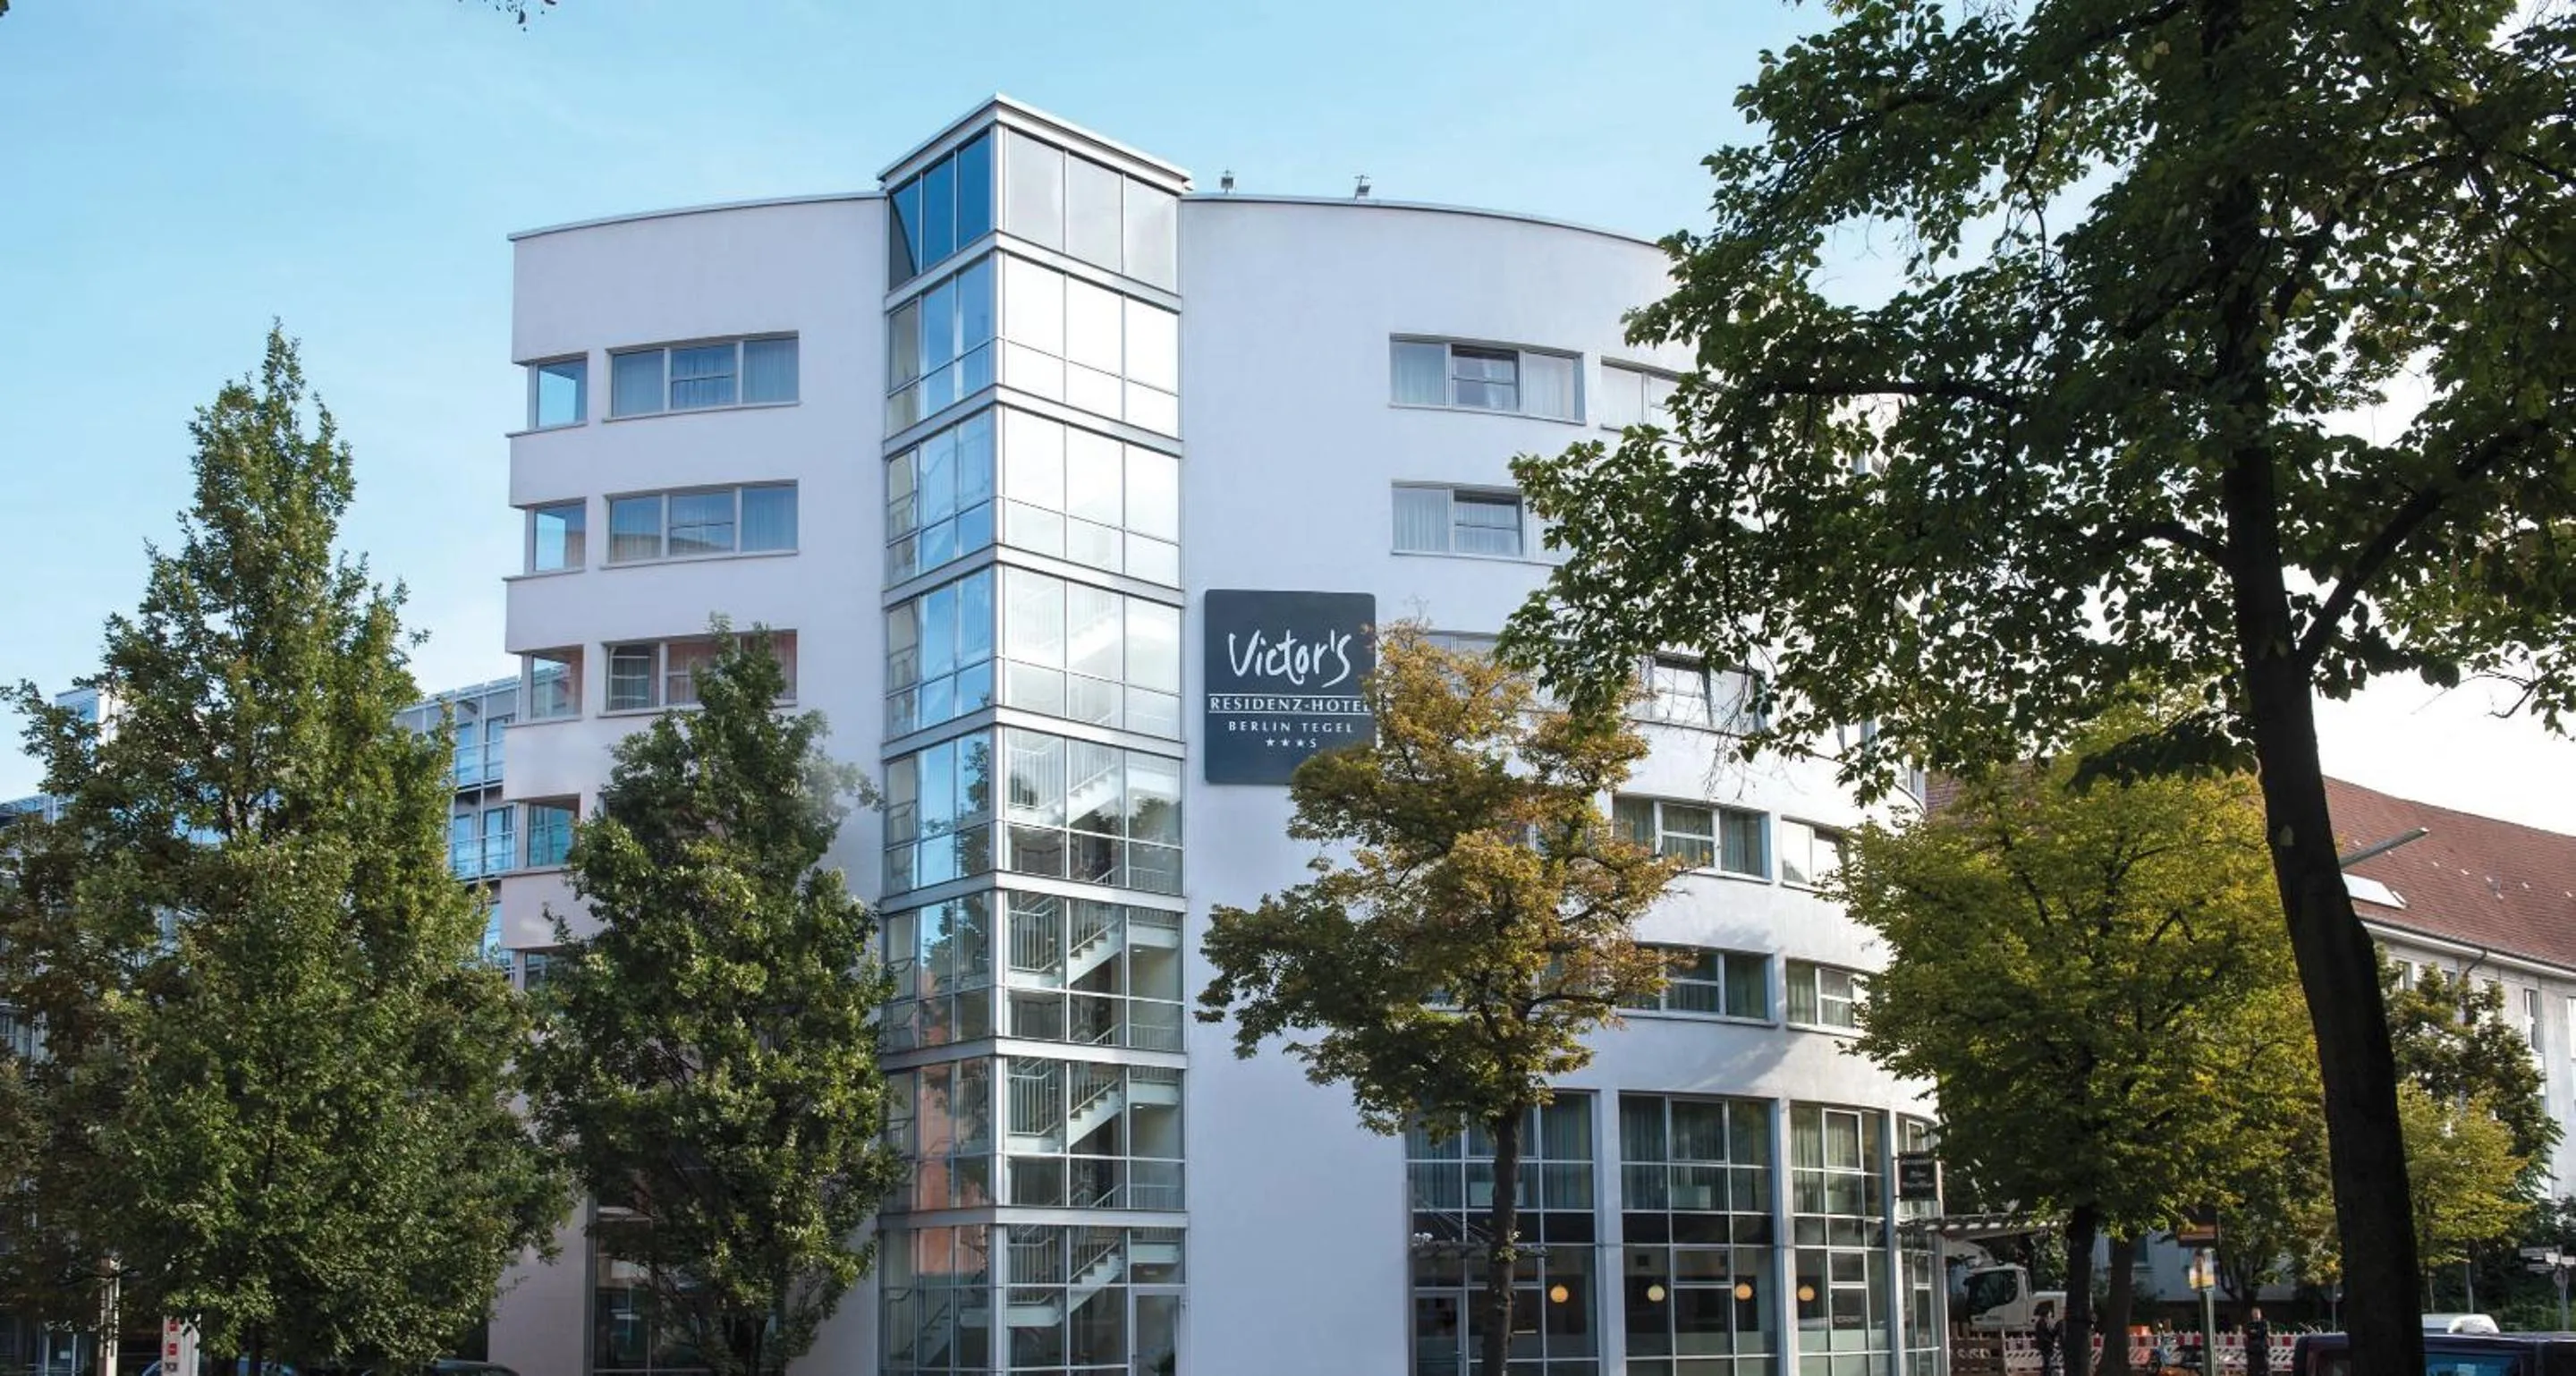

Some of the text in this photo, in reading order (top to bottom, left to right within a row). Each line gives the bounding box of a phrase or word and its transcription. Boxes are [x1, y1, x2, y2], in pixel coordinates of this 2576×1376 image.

[1228, 629, 1352, 688] Victor's
[1210, 697, 1371, 712] RESIDENZ-HOTEL
[1229, 720, 1353, 733] BERLIN TEGEL
